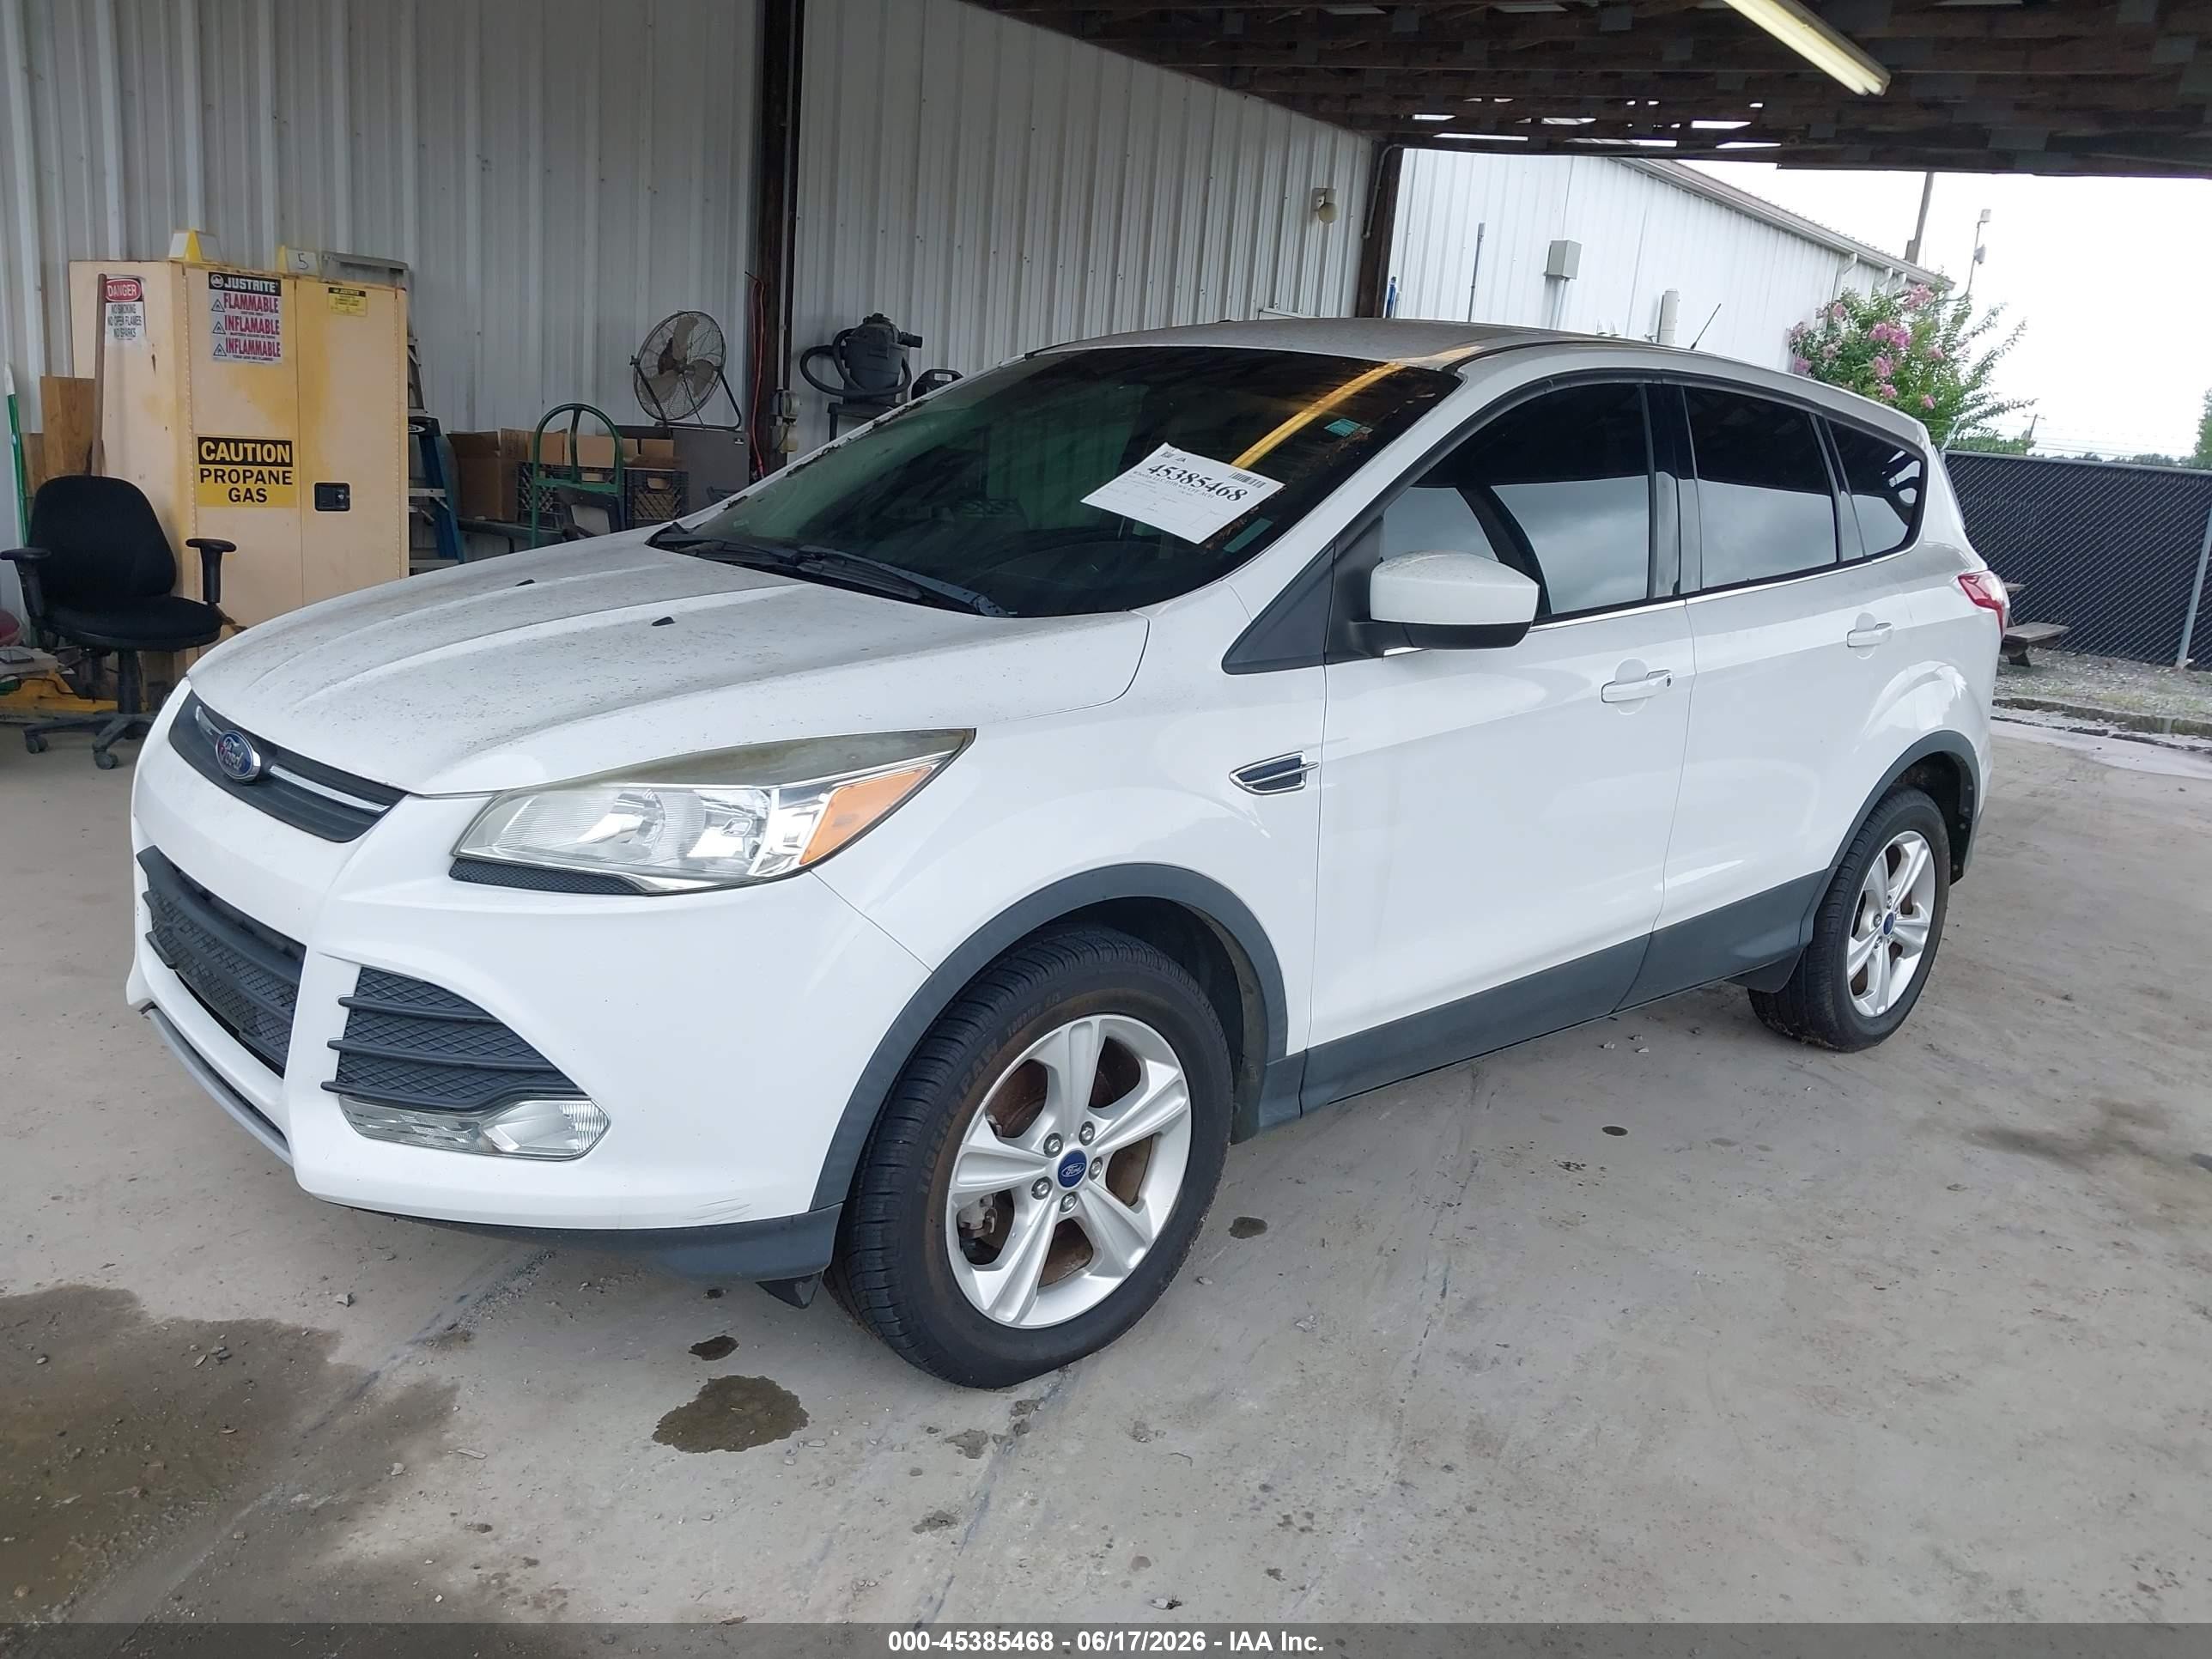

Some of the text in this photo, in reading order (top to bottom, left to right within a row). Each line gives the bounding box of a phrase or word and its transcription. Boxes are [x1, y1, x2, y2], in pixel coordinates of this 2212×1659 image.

[297, 252, 309, 270] 5
[106, 283, 137, 297] DANGER
[224, 276, 276, 293] JUSTRITE
[223, 292, 279, 313] FLAMMABLE
[224, 314, 281, 336] INFLAMABLE
[225, 337, 282, 358] INFLAMMABLE
[201, 441, 291, 464] CAUTION
[199, 468, 294, 485] PROPANE
[1147, 464, 1249, 501] 45385468
[228, 487, 268, 503] GAS
